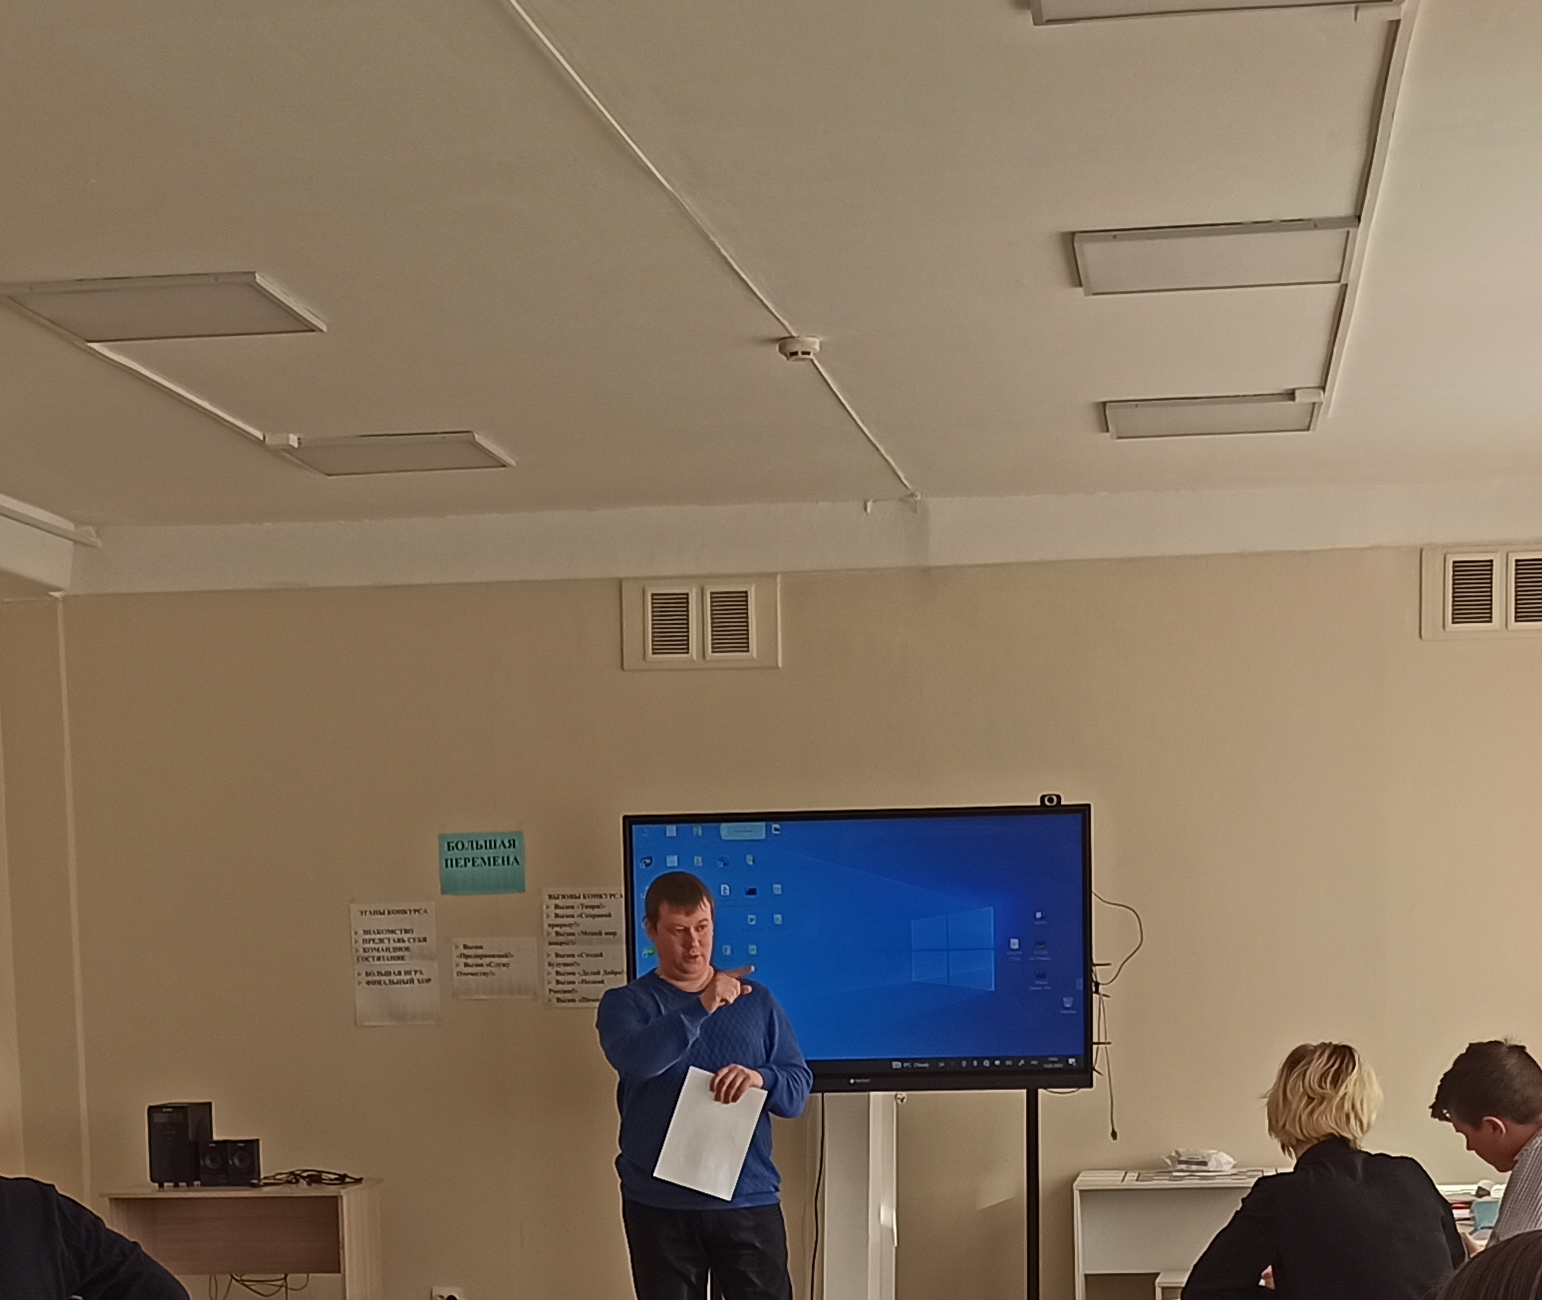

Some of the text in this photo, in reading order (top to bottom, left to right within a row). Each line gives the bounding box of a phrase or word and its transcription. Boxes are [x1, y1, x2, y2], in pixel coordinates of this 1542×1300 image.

[446, 838, 516, 852] БОЛЬШАЯ
[444, 855, 520, 869] ПЕРЕМЕНА
[403, 969, 424, 977] ИГРА
[365, 977, 415, 986] ФИНАЛЬНЫЙ
